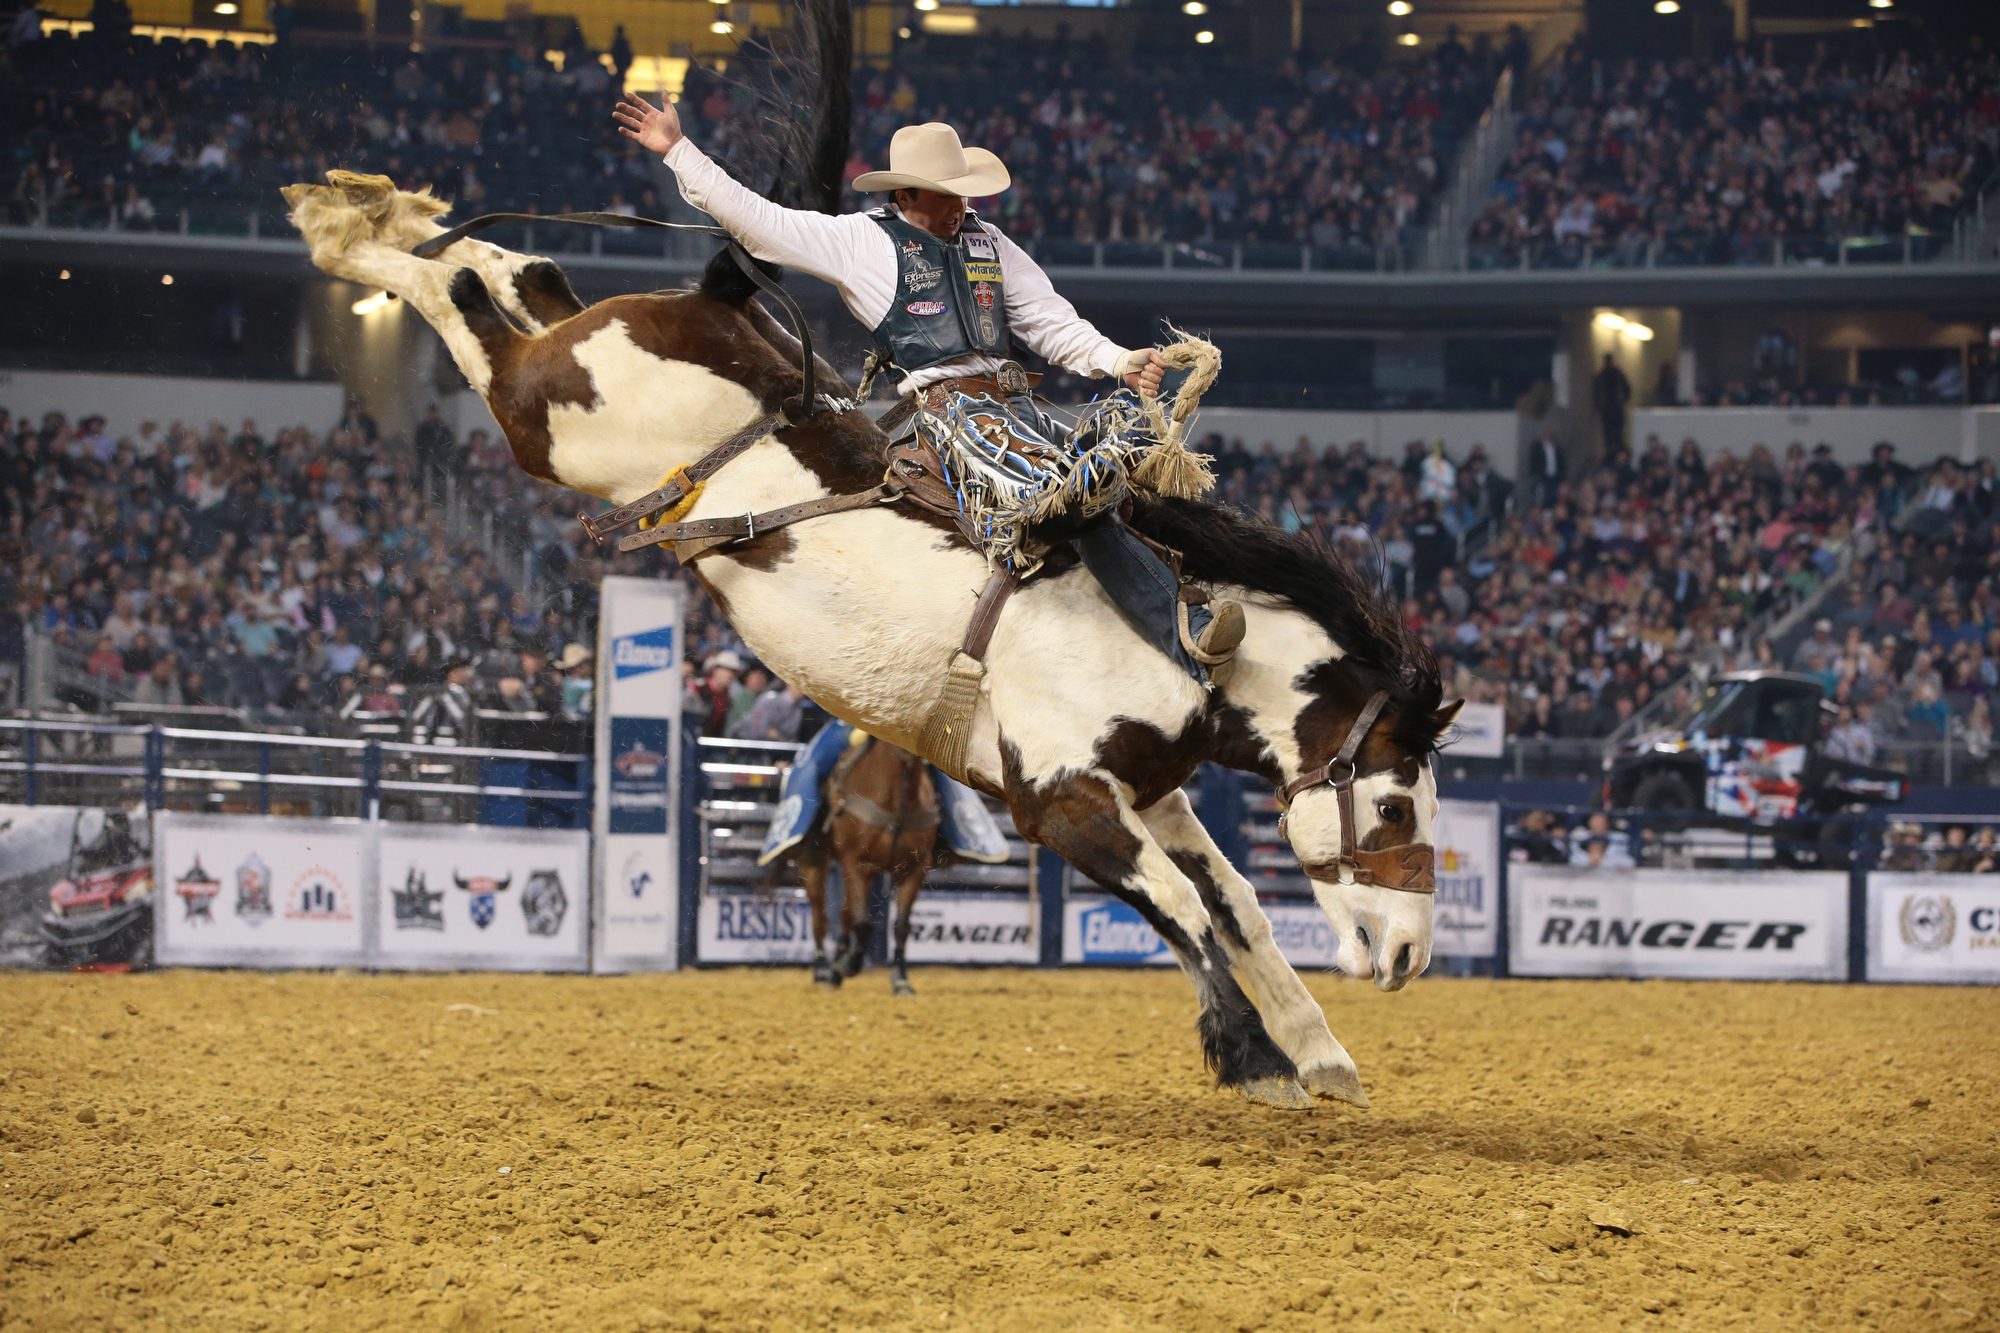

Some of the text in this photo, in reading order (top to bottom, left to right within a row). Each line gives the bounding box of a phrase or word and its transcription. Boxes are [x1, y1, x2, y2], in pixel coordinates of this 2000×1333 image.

[968, 237, 989, 248] 974
[908, 923, 1031, 943] RANGER
[1538, 916, 1811, 950] RANGER
